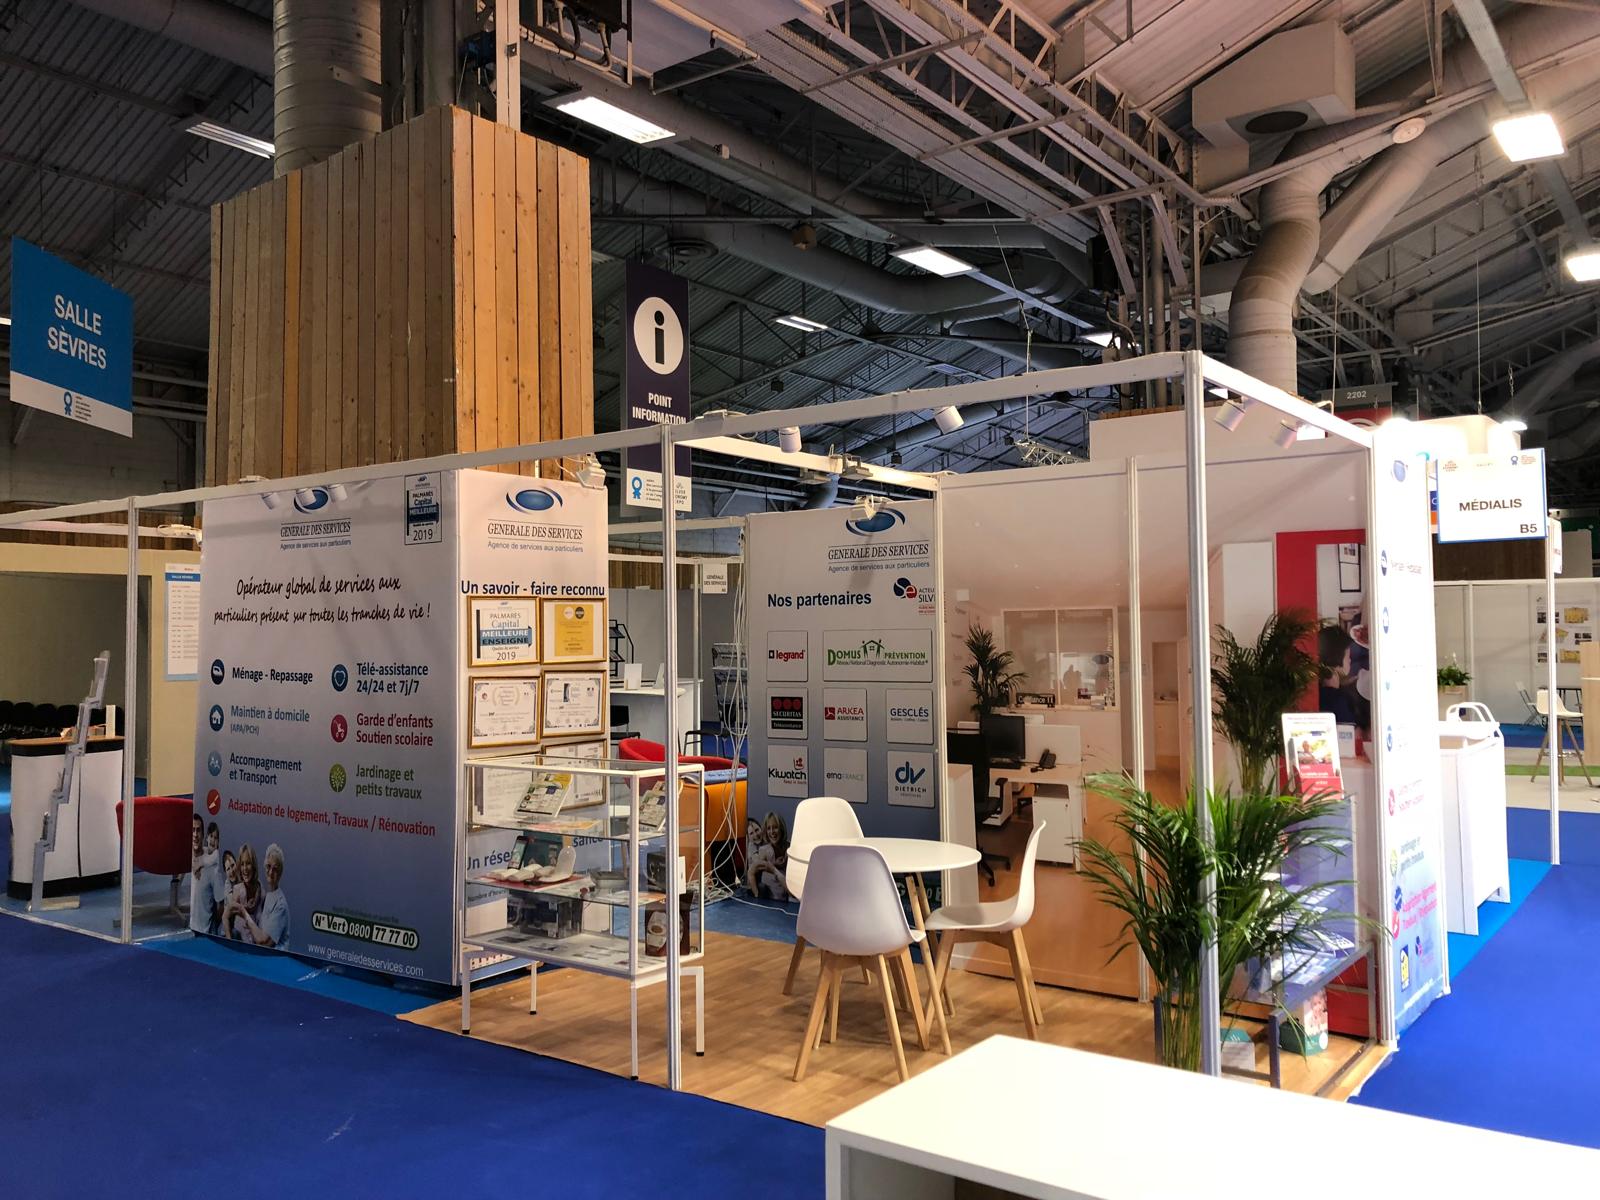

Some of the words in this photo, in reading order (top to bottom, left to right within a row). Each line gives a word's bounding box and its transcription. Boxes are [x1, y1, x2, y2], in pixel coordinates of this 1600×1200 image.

[54, 294, 102, 336] SALLE
[47, 325, 107, 369] SÈVRES
[648, 392, 672, 409] POINT
[1346, 391, 1366, 399] 2202
[632, 406, 687, 425] INFORMATION
[1459, 498, 1522, 512] MÉDIALIS
[280, 525, 310, 538] GENERALE
[310, 524, 322, 536] DES
[322, 521, 351, 534] SERVICES
[413, 528, 433, 541] 2019
[487, 522, 531, 537] GENERALE
[531, 526, 547, 538] DES
[547, 528, 583, 540] SERVICES
[1520, 523, 1538, 533] B5
[488, 541, 509, 550] Agence
[519, 543, 543, 551] services
[554, 544, 583, 553] particuliers
[828, 547, 870, 560] GENERALE
[871, 546, 888, 557] DES
[888, 543, 929, 557] SERVICES
[828, 564, 850, 573] Agence
[850, 563, 858, 571] de
[858, 563, 884, 571] services
[897, 561, 929, 570] particuliers
[236, 576, 283, 600] Opérateur
[285, 577, 316, 599] global
[318, 575, 332, 592] de
[335, 574, 375, 595] services
[378, 577, 401, 590] aux
[461, 580, 479, 595] Un
[482, 581, 520, 595] savoir
[530, 581, 558, 595] faire
[561, 584, 605, 596] reconnu
[767, 593, 792, 607] Nos
[797, 591, 872, 609] partenaires
[214, 607, 257, 625] particuliers
[260, 606, 289, 626] présent
[293, 611, 307, 623] sur
[309, 607, 335, 623] toutes
[337, 606, 348, 622] les
[351, 603, 390, 622] tranches
[393, 602, 405, 619] de
[409, 602, 424, 620] vie
[492, 620, 520, 629] Capital
[482, 637, 529, 645] ENSEIGNE
[496, 651, 516, 661] 2019
[776, 650, 804, 662] legrand
[884, 650, 926, 660] PRÉVENTION
[232, 667, 263, 684] Ménage
[270, 668, 313, 685] Repassage
[356, 662, 429, 676] Télé-assistance
[356, 680, 384, 694] 24/24
[387, 681, 397, 693] et
[399, 679, 419, 696] 7j/7
[230, 705, 266, 719] Maintien
[268, 709, 273, 720] à
[275, 708, 310, 722] domicile
[356, 712, 385, 727] Garde
[890, 707, 929, 717] GESCLÉS
[230, 723, 260, 736] (APA/PCH)
[356, 730, 392, 744] Soutien
[395, 732, 433, 747] scolaire
[230, 752, 302, 772] Accompagnement
[229, 769, 237, 780] et
[239, 769, 277, 786] Transport
[356, 764, 401, 782] Jardinage
[403, 769, 414, 782] et
[769, 768, 807, 780] Kiwatch
[355, 783, 383, 798] petits
[385, 786, 422, 800] travaux
[228, 798, 273, 816] Adaptation
[275, 806, 285, 818] de
[287, 807, 331, 826] logement,
[333, 812, 369, 828] Travaux
[379, 815, 435, 836] Rénovation
[484, 850, 512, 867] rése
[326, 915, 346, 932] Vert
[349, 922, 371, 939] 0800
[375, 926, 387, 941] 77
[389, 929, 401, 943] 77
[402, 931, 415, 946] 00
[308, 943, 424, 977] www.generaledesservices.com
